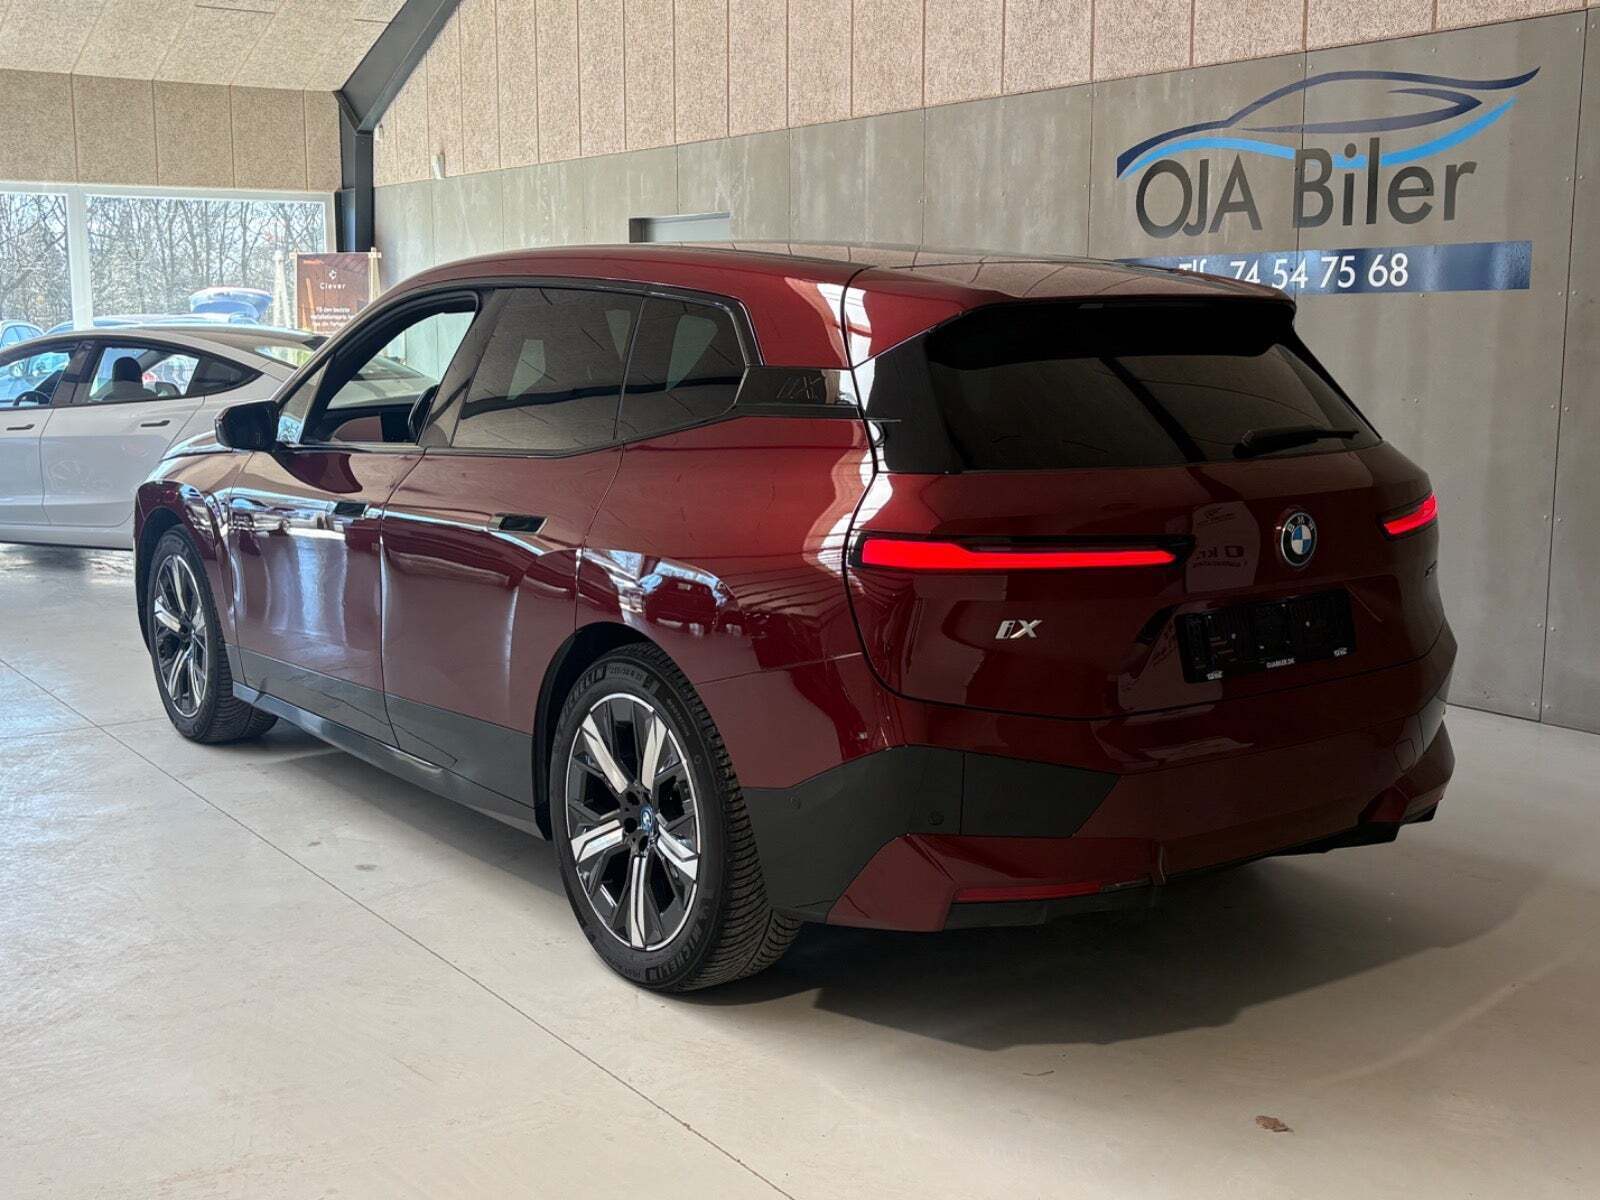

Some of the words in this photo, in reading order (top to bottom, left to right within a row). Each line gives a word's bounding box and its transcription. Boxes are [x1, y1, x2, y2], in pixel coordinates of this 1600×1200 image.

[1136, 153, 1263, 239] OJA
[1292, 137, 1477, 230] Biler
[319, 282, 346, 290] Clever
[1229, 260, 1261, 284] 74
[1271, 258, 1308, 290] 54
[1319, 255, 1357, 289] 75
[1367, 253, 1409, 287] 68
[995, 619, 1042, 640] iX
